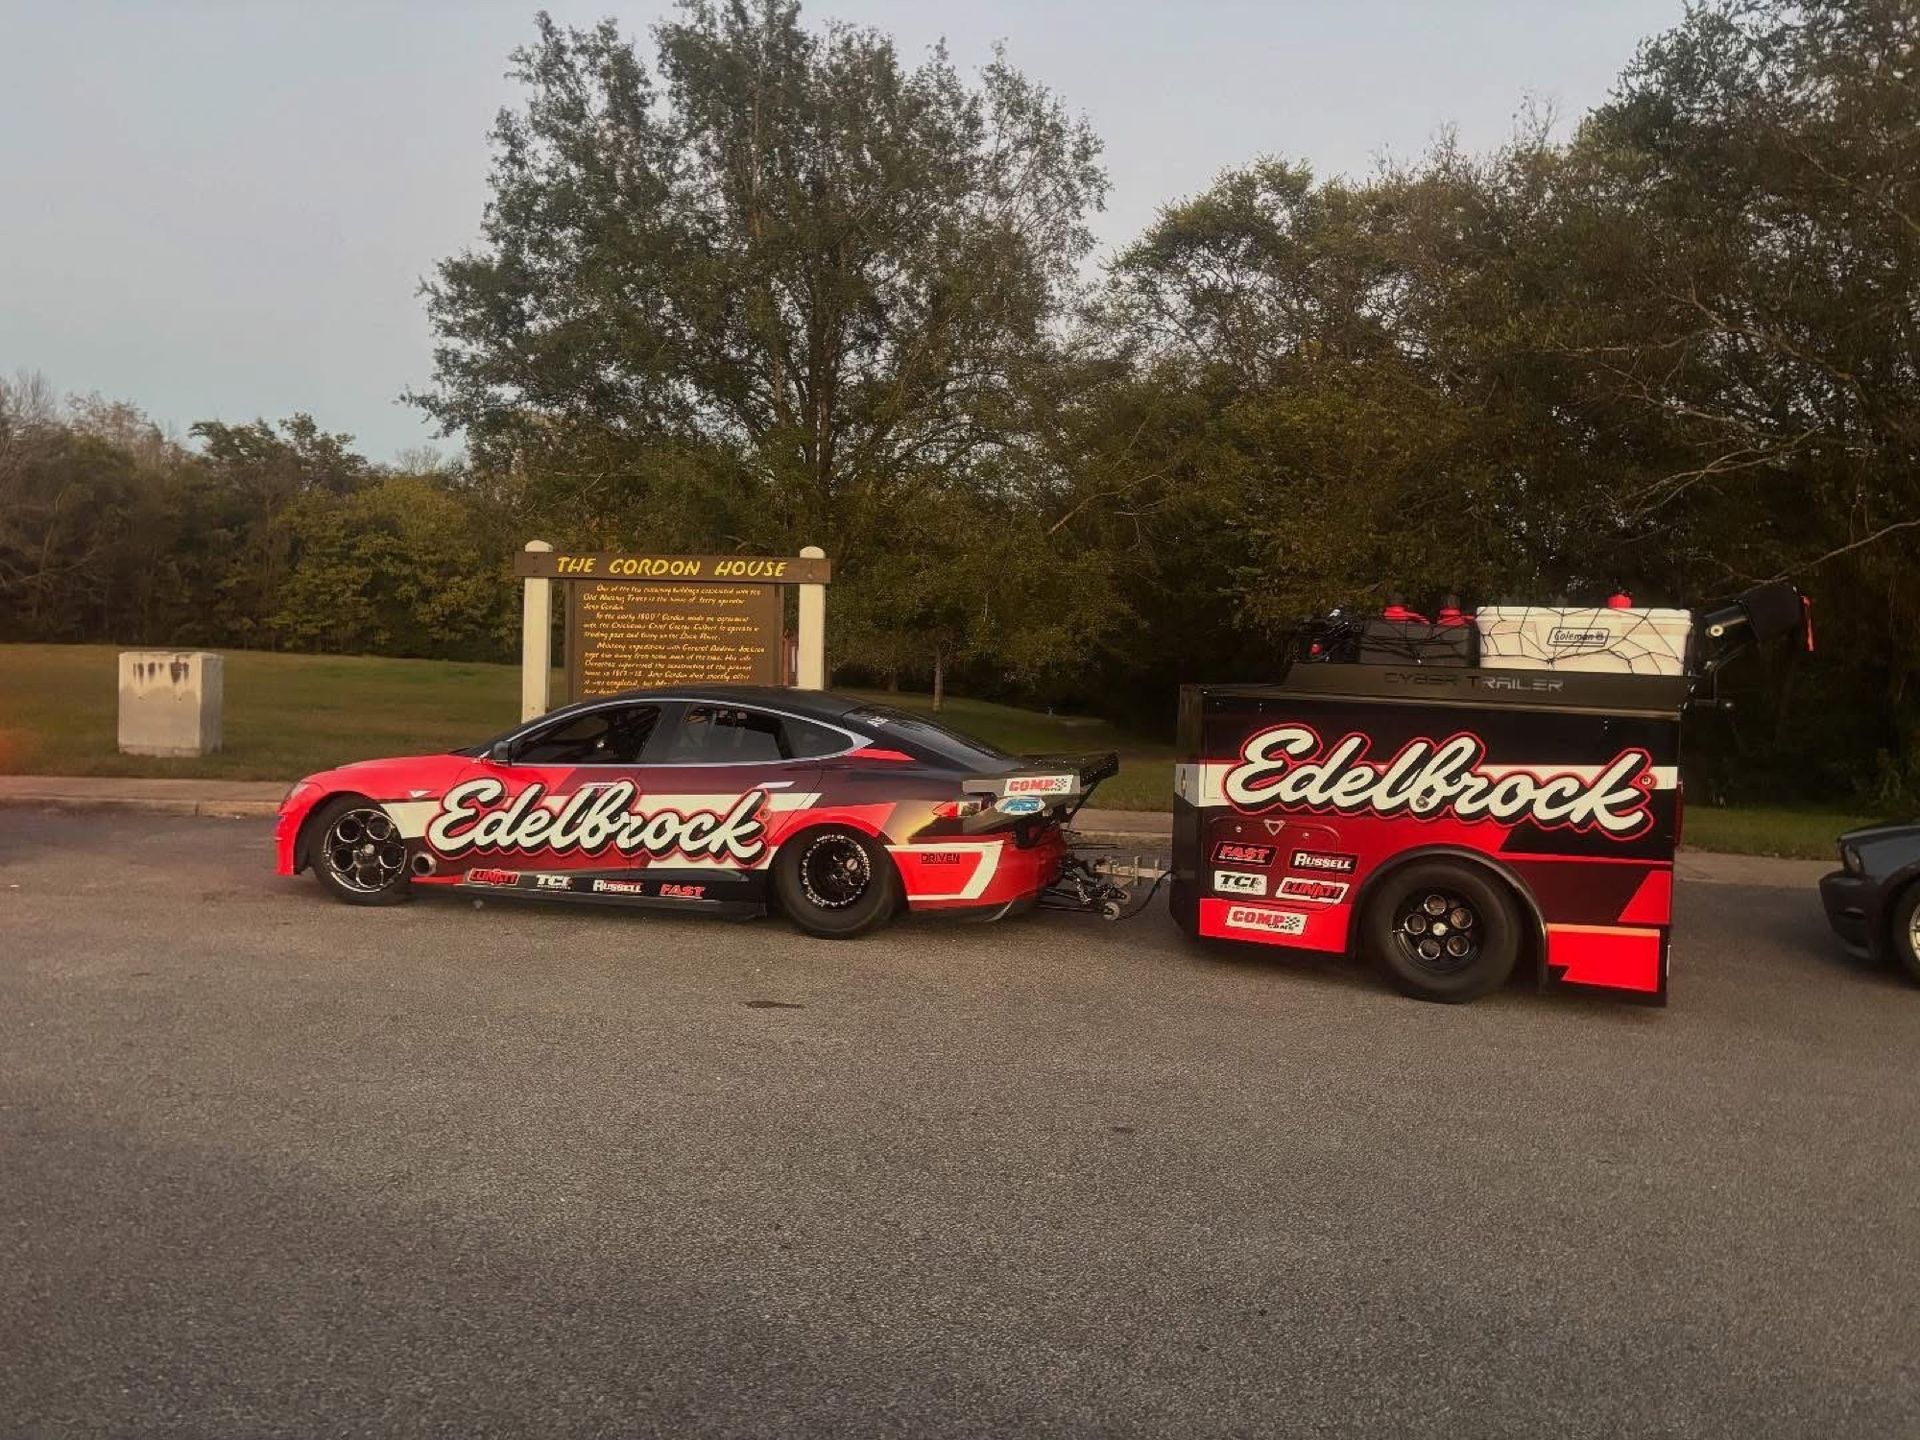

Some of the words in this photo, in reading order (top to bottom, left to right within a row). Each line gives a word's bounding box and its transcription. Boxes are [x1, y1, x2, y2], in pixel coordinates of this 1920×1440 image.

[557, 556, 597, 573] THE
[608, 558, 701, 577] GORDON
[714, 560, 789, 577] HOUSE
[1554, 630, 1594, 641] Coleman
[1465, 675, 1565, 692] TRAILER
[1008, 779, 1055, 791] COMP
[1228, 727, 1645, 833] Edelbrock
[429, 777, 765, 859] Edelbrock
[921, 854, 960, 864] DRIVEN
[1220, 845, 1270, 859] FAST
[536, 874, 570, 886] TCI
[1220, 874, 1258, 888] TCI
[660, 884, 704, 897] FAST
[1281, 881, 1344, 899] LUNATI
[1232, 910, 1285, 925] COMP
